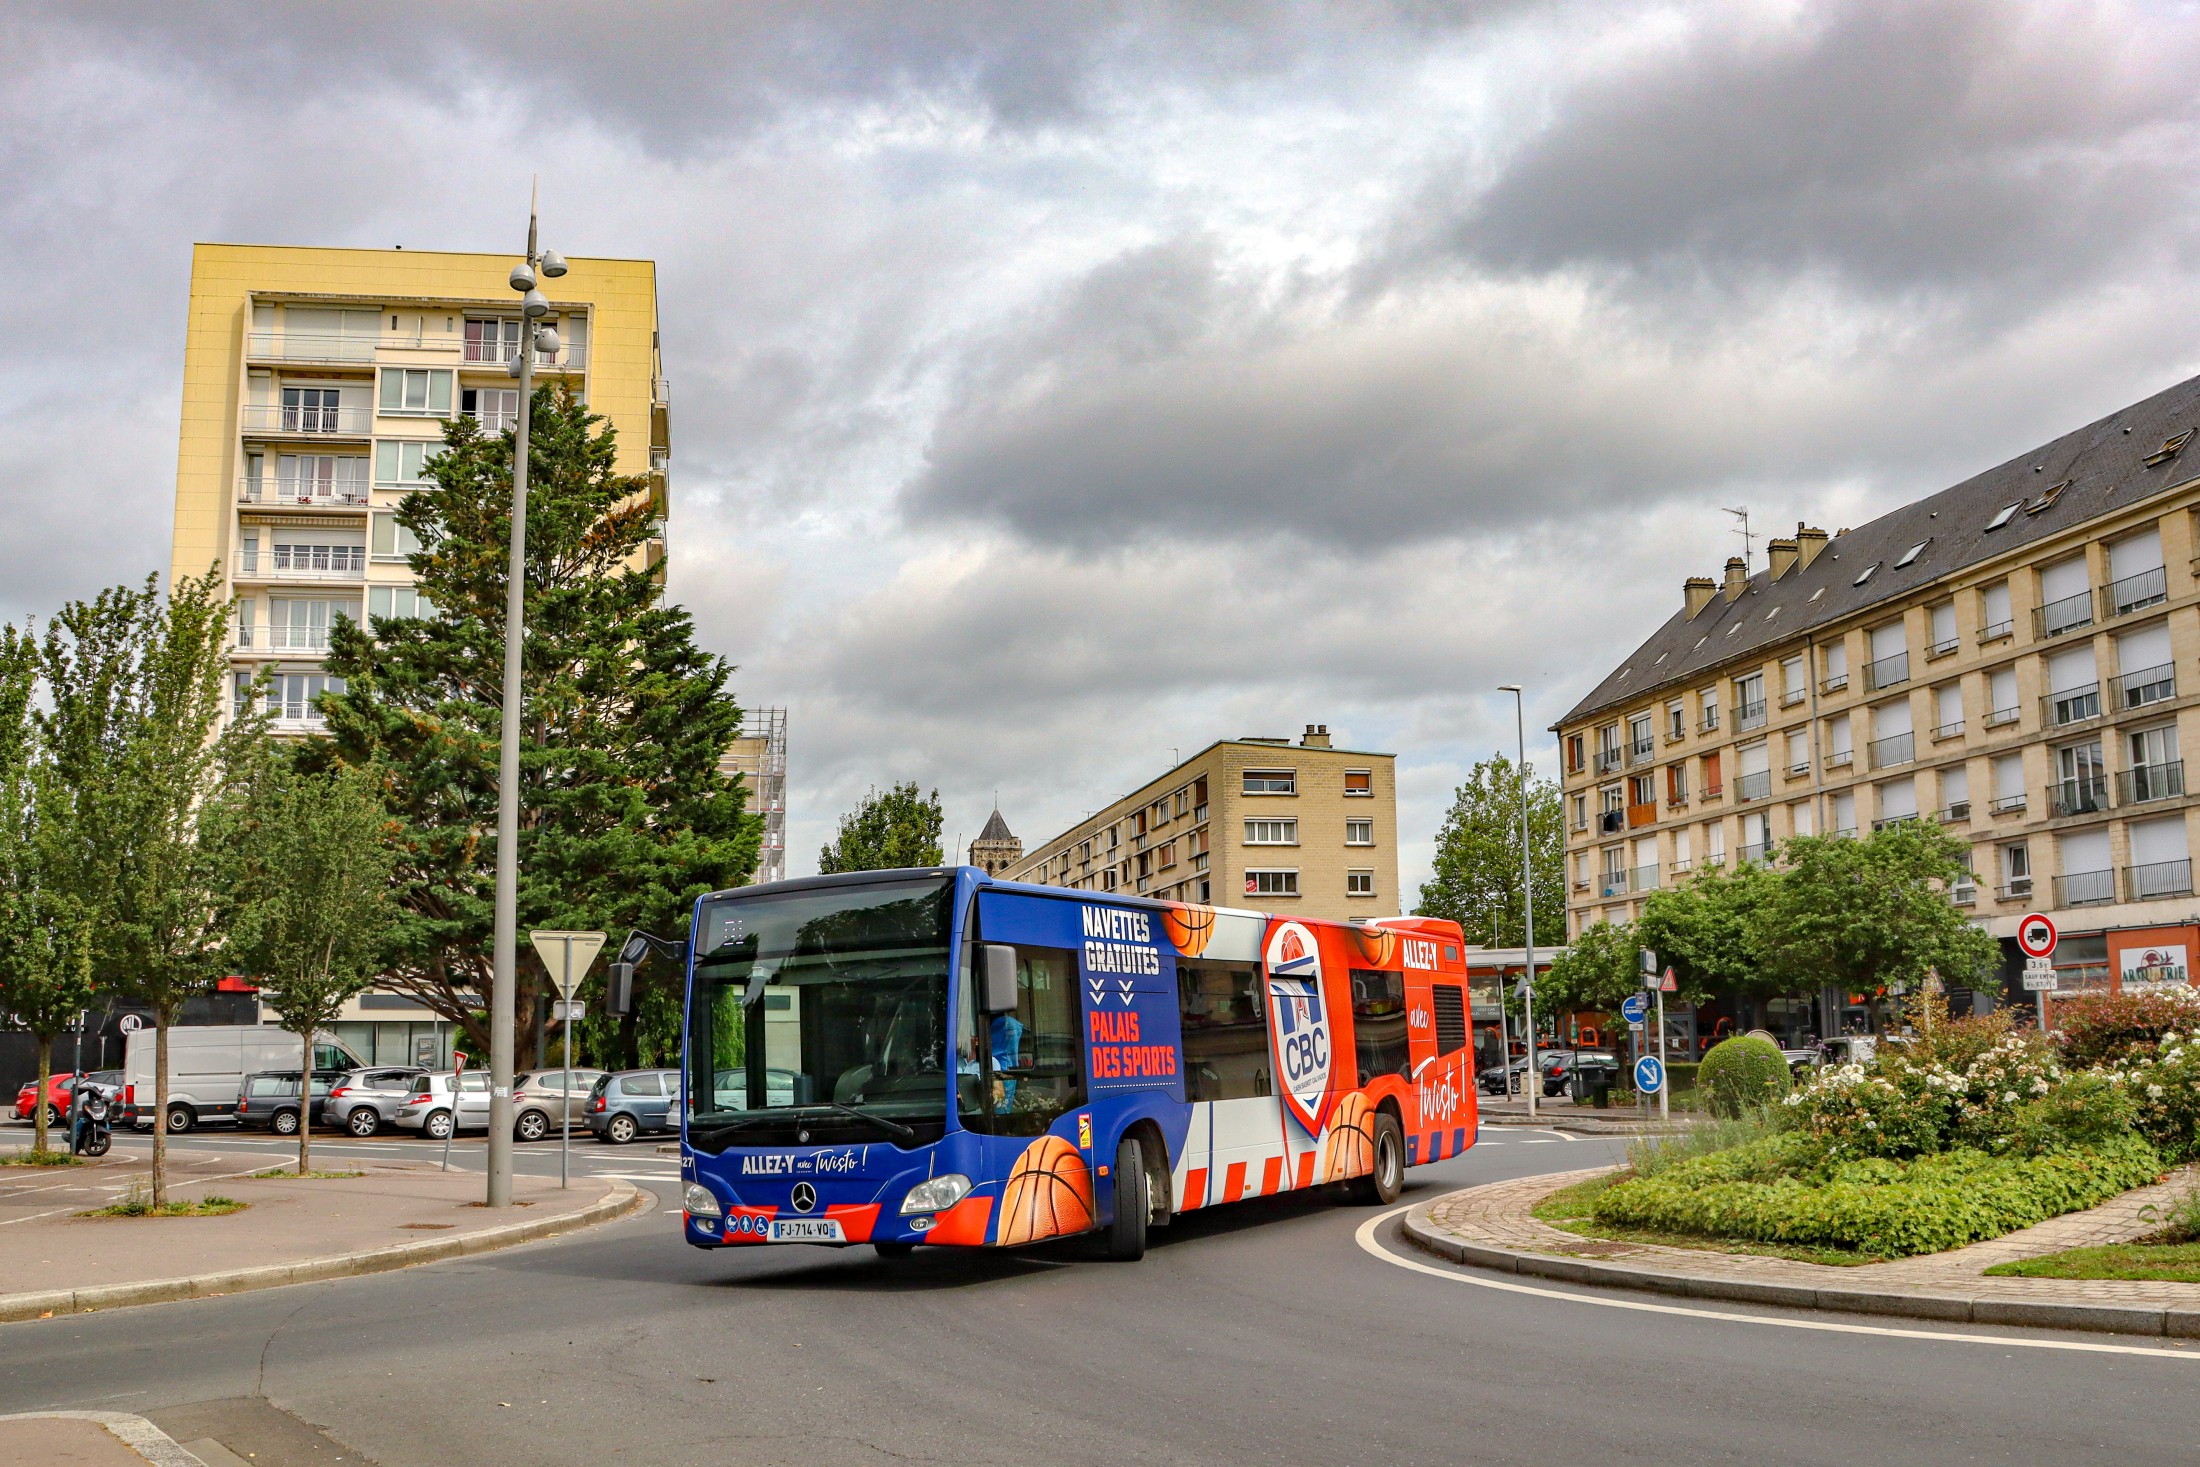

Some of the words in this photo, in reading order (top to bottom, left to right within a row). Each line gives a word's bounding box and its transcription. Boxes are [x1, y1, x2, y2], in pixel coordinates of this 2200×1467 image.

[1082, 905, 1150, 943] NAVETTES
[1085, 941, 1160, 976] GRATUITES
[1403, 939, 1438, 971] ALLEZ-Y
[2122, 966, 2186, 982] ARMUERIE
[1090, 1011, 1140, 1043] PALAIS
[1410, 1003, 1430, 1029] avec
[1092, 1046, 1121, 1079] DES
[1123, 1045, 1177, 1078] SPORTS
[1286, 1027, 1327, 1080] CBC
[1412, 1055, 1459, 1129] Twisto
[742, 1155, 795, 1175] ALLEZ-Y
[797, 1160, 813, 1169] avec
[810, 1149, 859, 1174] Twisto
